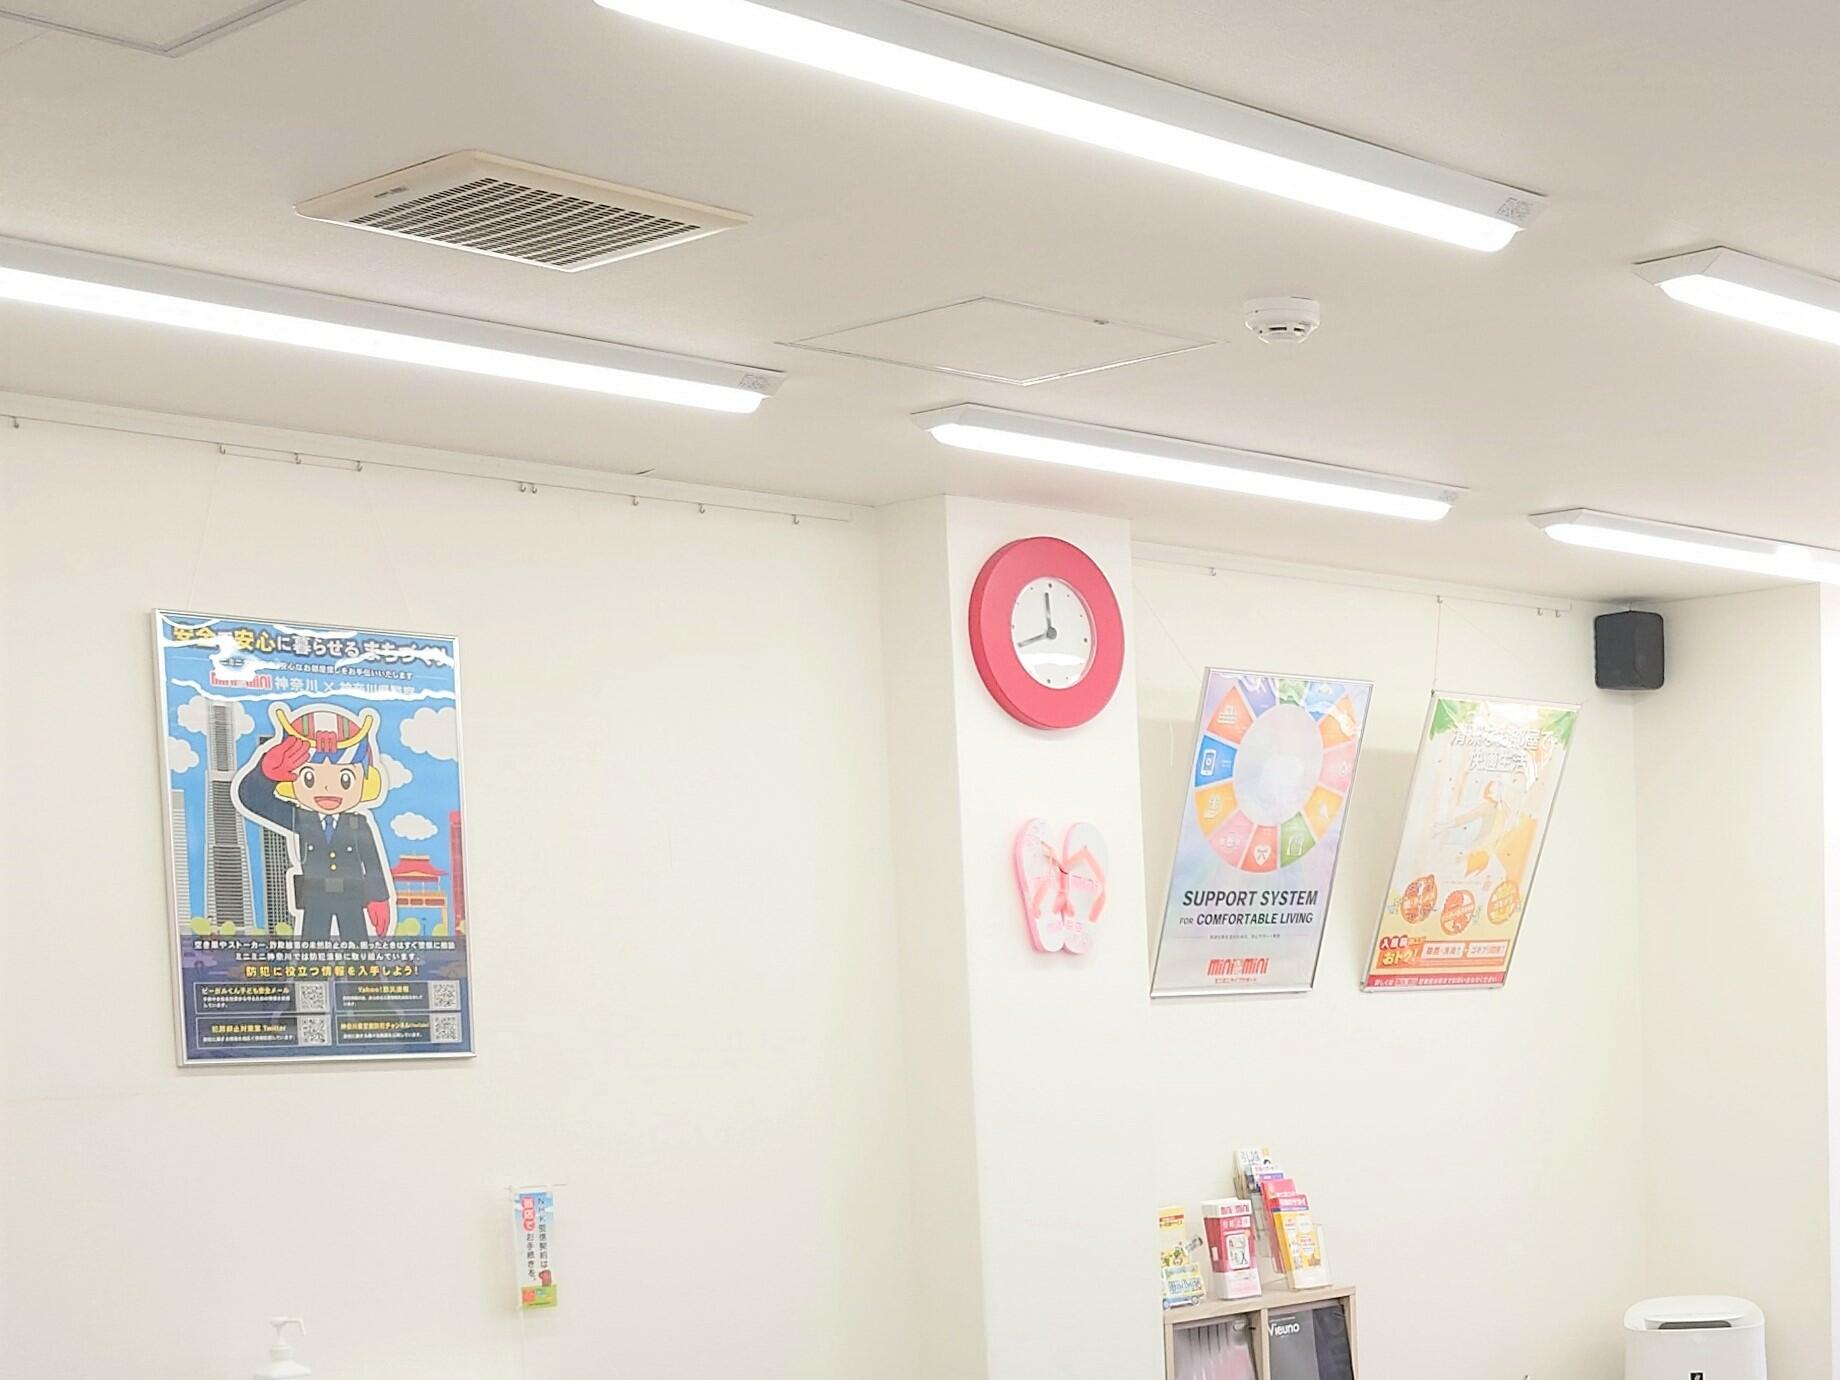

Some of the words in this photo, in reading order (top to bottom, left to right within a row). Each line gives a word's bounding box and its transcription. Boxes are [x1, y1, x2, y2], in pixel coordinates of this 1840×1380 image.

[1182, 890, 1258, 907] SUPPORT
[1260, 890, 1319, 906] SYSTEM
[1179, 917, 1194, 925] FOR
[1196, 912, 1279, 925] COMFORTABLE
[1280, 912, 1314, 924] LIVING
[1207, 958, 1235, 976] mini
[1241, 958, 1270, 975] mini
